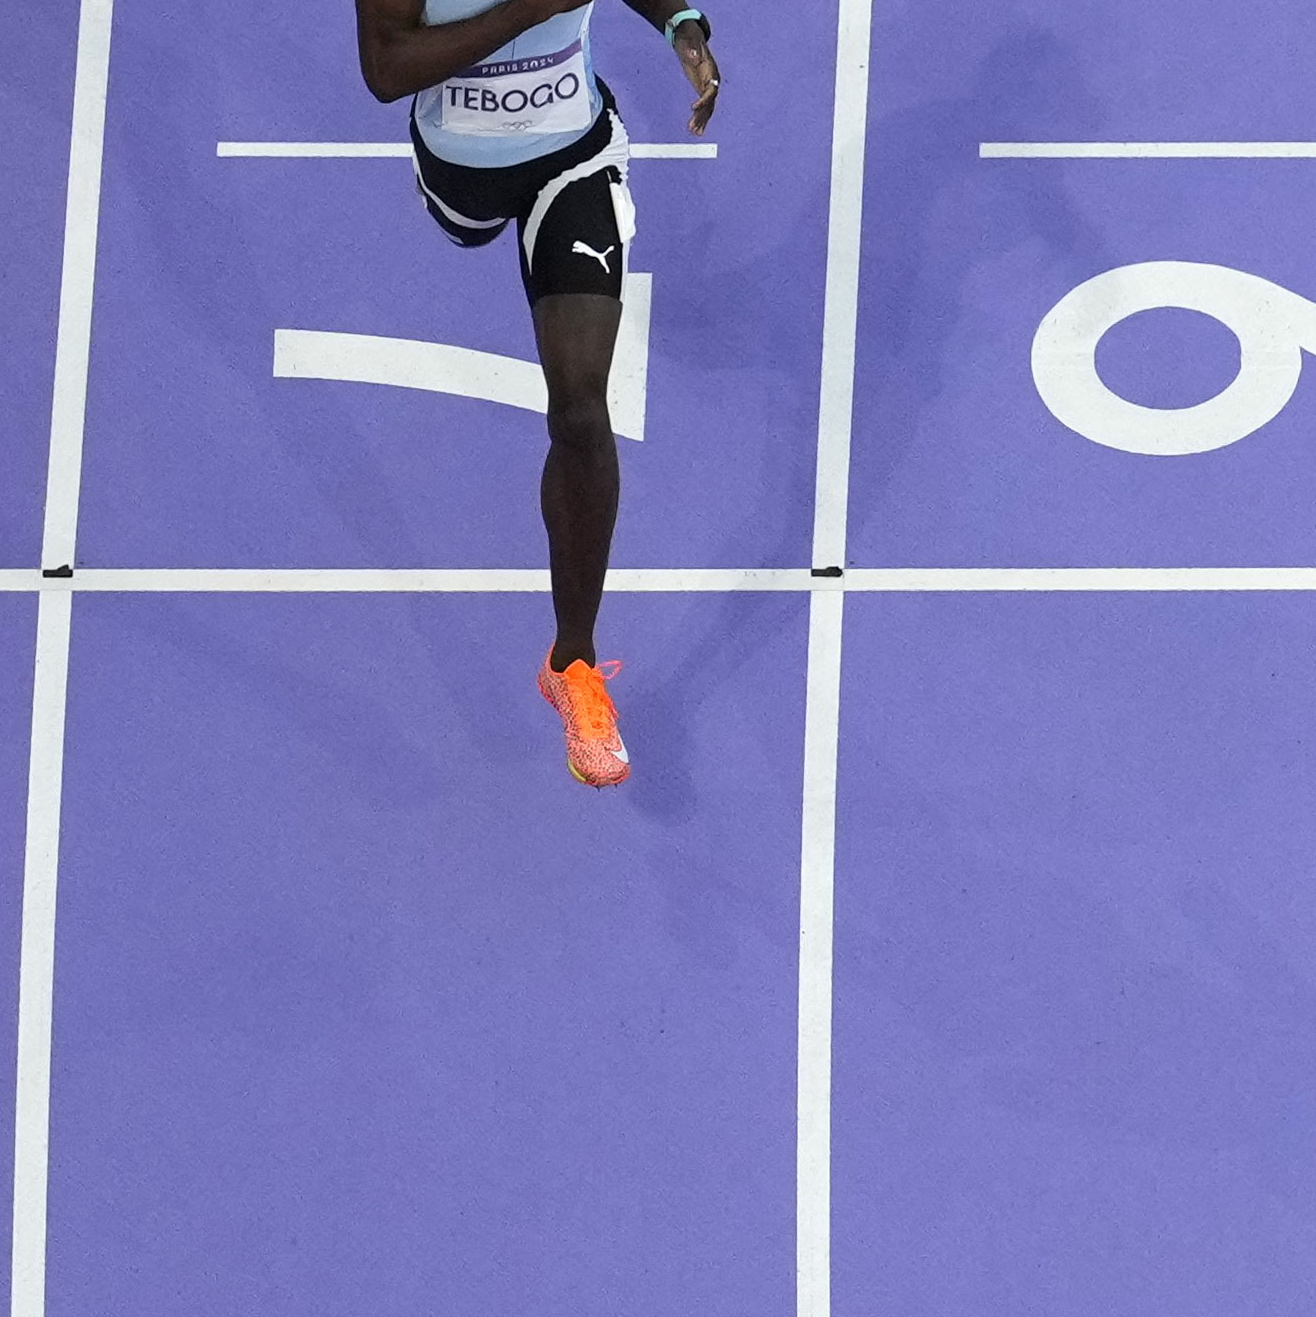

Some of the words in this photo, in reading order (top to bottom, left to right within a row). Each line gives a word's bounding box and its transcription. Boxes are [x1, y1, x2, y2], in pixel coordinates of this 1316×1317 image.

[482, 63, 518, 74] PARIS
[523, 58, 554, 70] 2024
[445, 72, 580, 113] TEBOGO
[274, 272, 651, 442] 7
